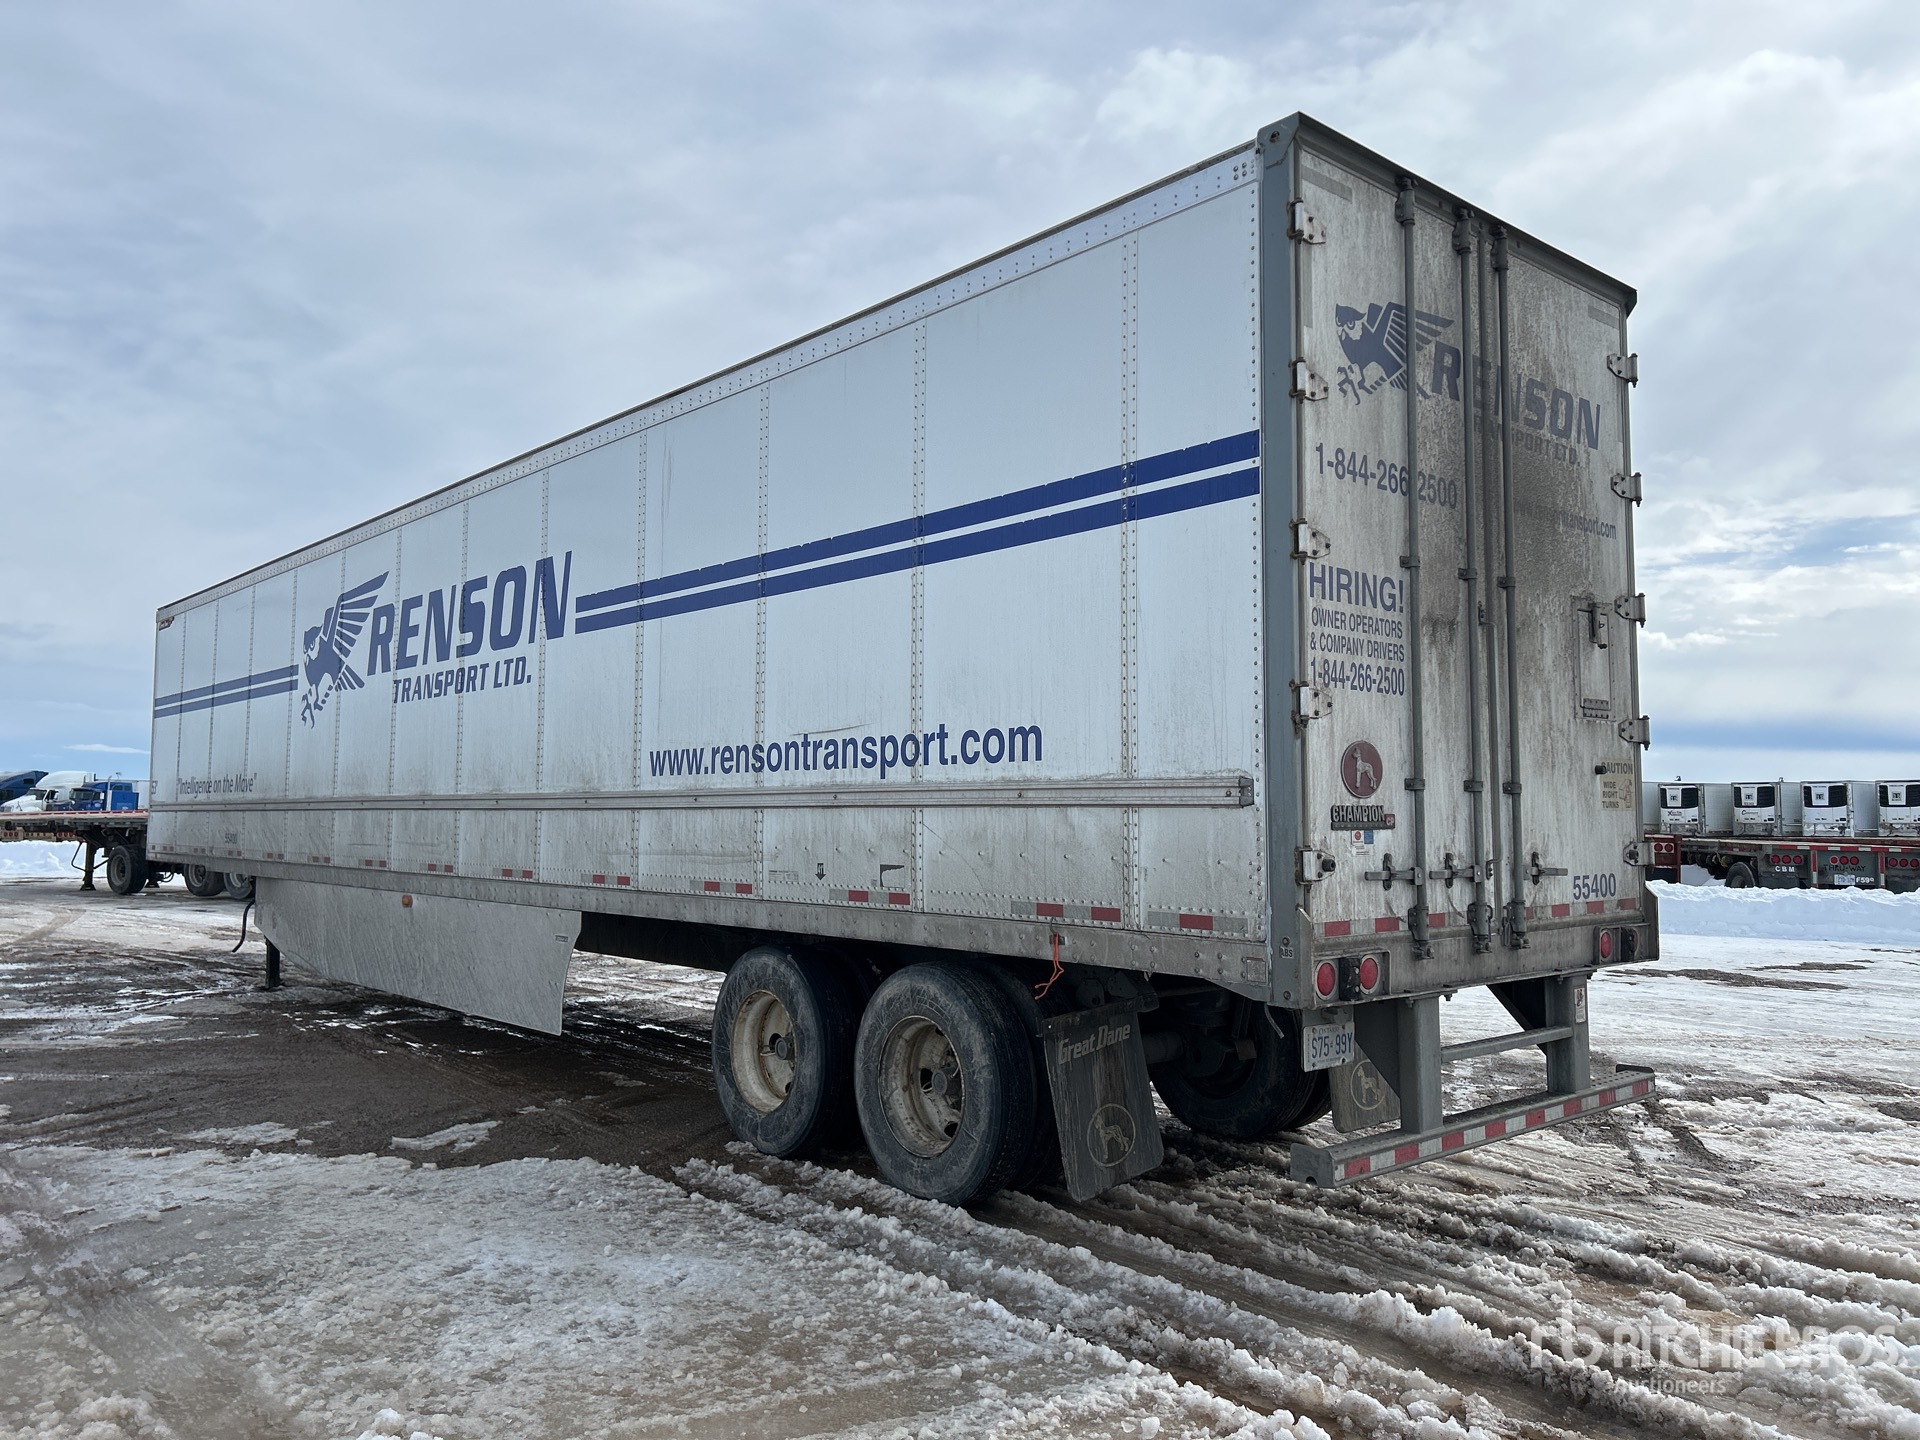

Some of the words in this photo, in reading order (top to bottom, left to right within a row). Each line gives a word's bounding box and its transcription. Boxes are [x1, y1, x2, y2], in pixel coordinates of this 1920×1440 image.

[1315, 442, 1457, 509] 1-844-2662500
[1309, 561, 1404, 613] HIRING!
[367, 551, 573, 676] RENSON
[1311, 606, 1346, 631] OWNER
[1348, 612, 1403, 640] OPERATORS
[1310, 631, 1317, 651] &
[1319, 632, 1365, 657] COMPANY
[1367, 639, 1405, 663] DRIVERS
[393, 662, 490, 704] TRANSPORT
[493, 656, 532, 689] LTD.
[1310, 656, 1405, 696] 1-844-266-2500
[650, 723, 1042, 780] www.rensontransport.com
[213, 779, 221, 794] on
[222, 773, 233, 793] the
[1602, 790, 1618, 799] RIGHT
[1603, 781, 1617, 789] WIDE
[1331, 804, 1385, 823] CHAMPION
[1602, 800, 1620, 809] TURNS
[1573, 872, 1616, 900] 55400
[1279, 946, 1293, 958] ABS
[1058, 1033, 1097, 1065] Great
[1096, 1023, 1132, 1051] Dane
